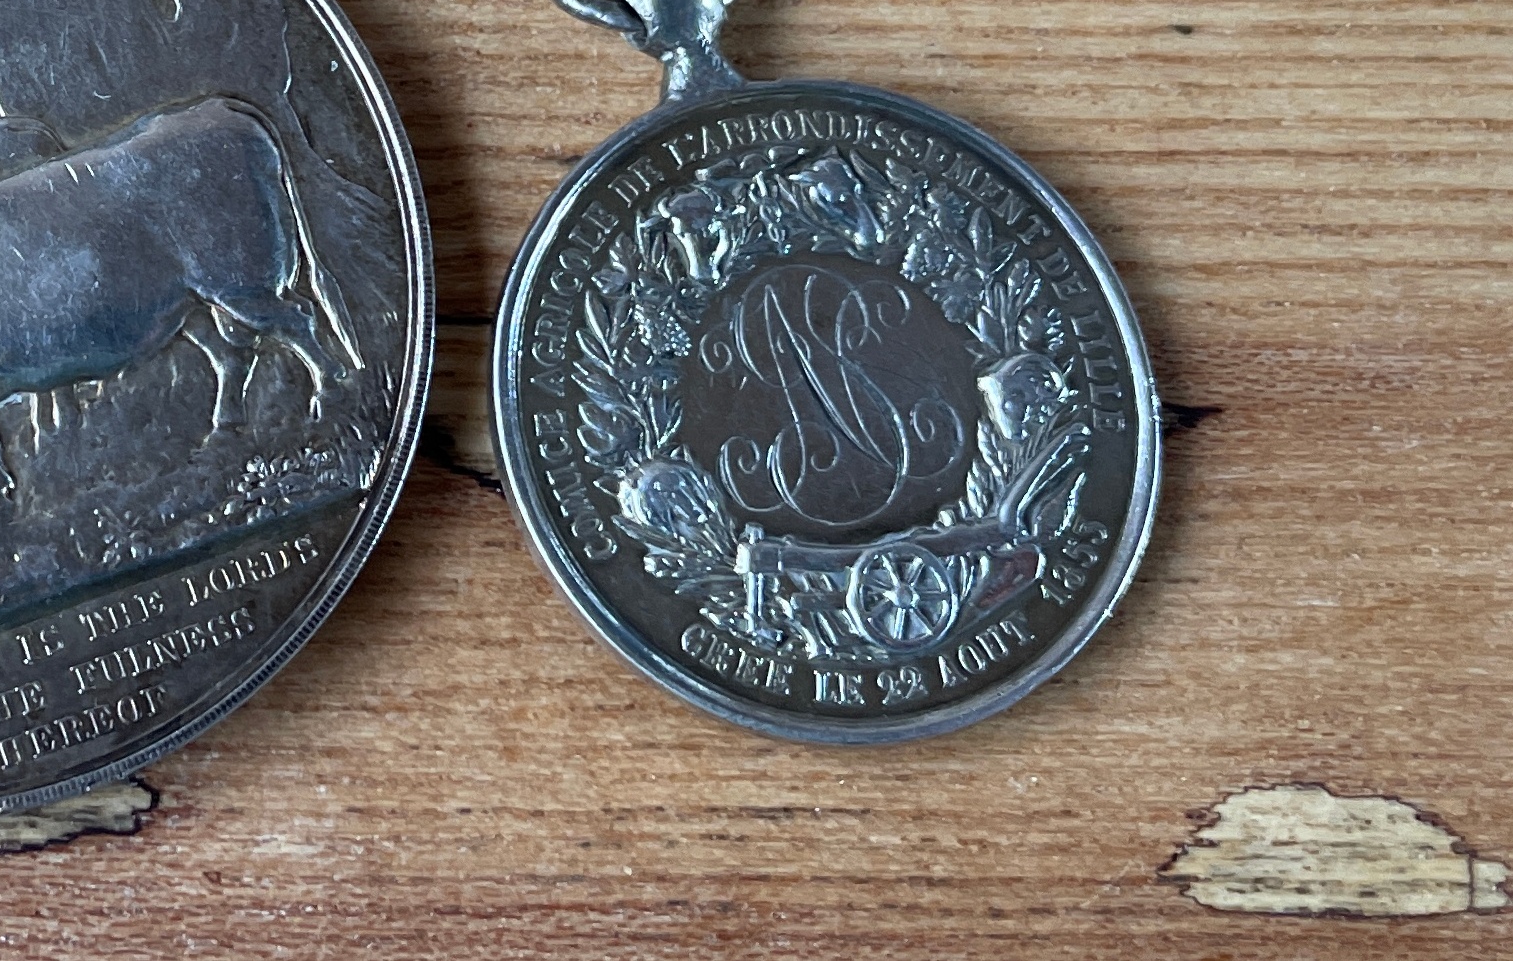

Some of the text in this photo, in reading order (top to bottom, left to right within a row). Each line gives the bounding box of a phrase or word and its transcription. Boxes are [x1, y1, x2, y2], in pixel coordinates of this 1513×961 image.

[529, 199, 620, 398] AGRICOLE
[607, 156, 665, 209] DE
[1037, 246, 1088, 301] DE
[1069, 309, 1127, 433] LILLE
[14, 625, 65, 666] IS
[77, 589, 165, 642] THE
[69, 605, 257, 695] FULNESS
[813, 668, 866, 706] LE
